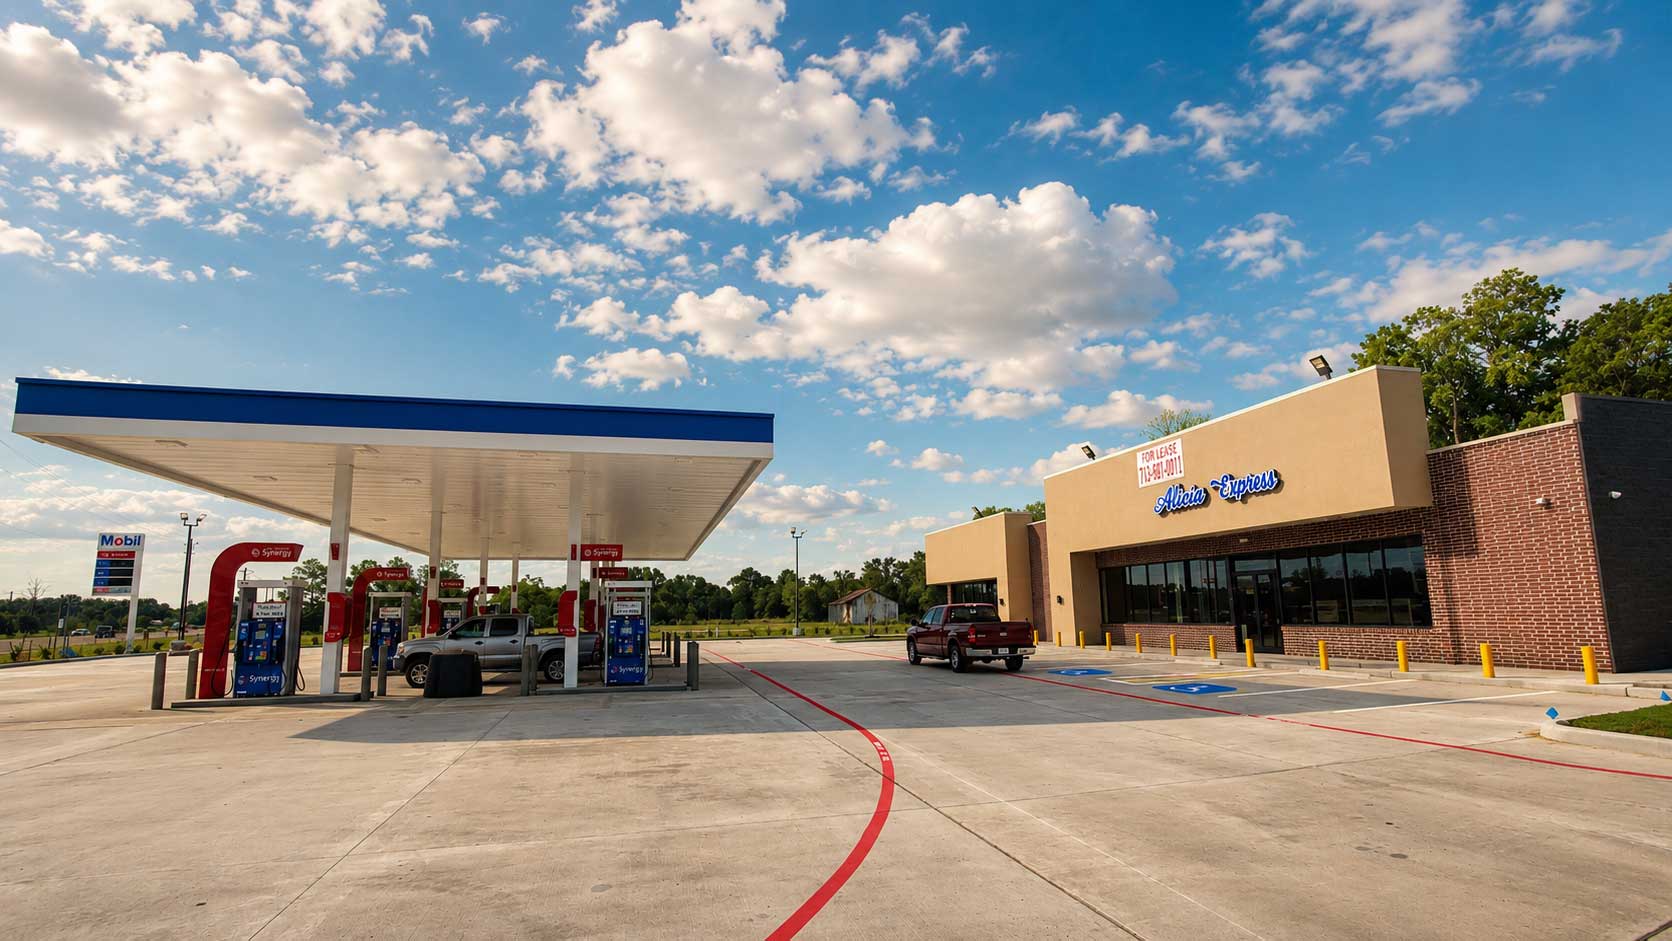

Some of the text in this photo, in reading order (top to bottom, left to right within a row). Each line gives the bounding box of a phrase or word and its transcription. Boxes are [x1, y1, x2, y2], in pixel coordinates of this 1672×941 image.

[1142, 442, 1177, 463] FOR LEASE
[1154, 469, 1278, 514] Alicia Express
[101, 535, 141, 546] Mobil
[262, 548, 292, 558] Synergy
[249, 674, 281, 684] Synergy
